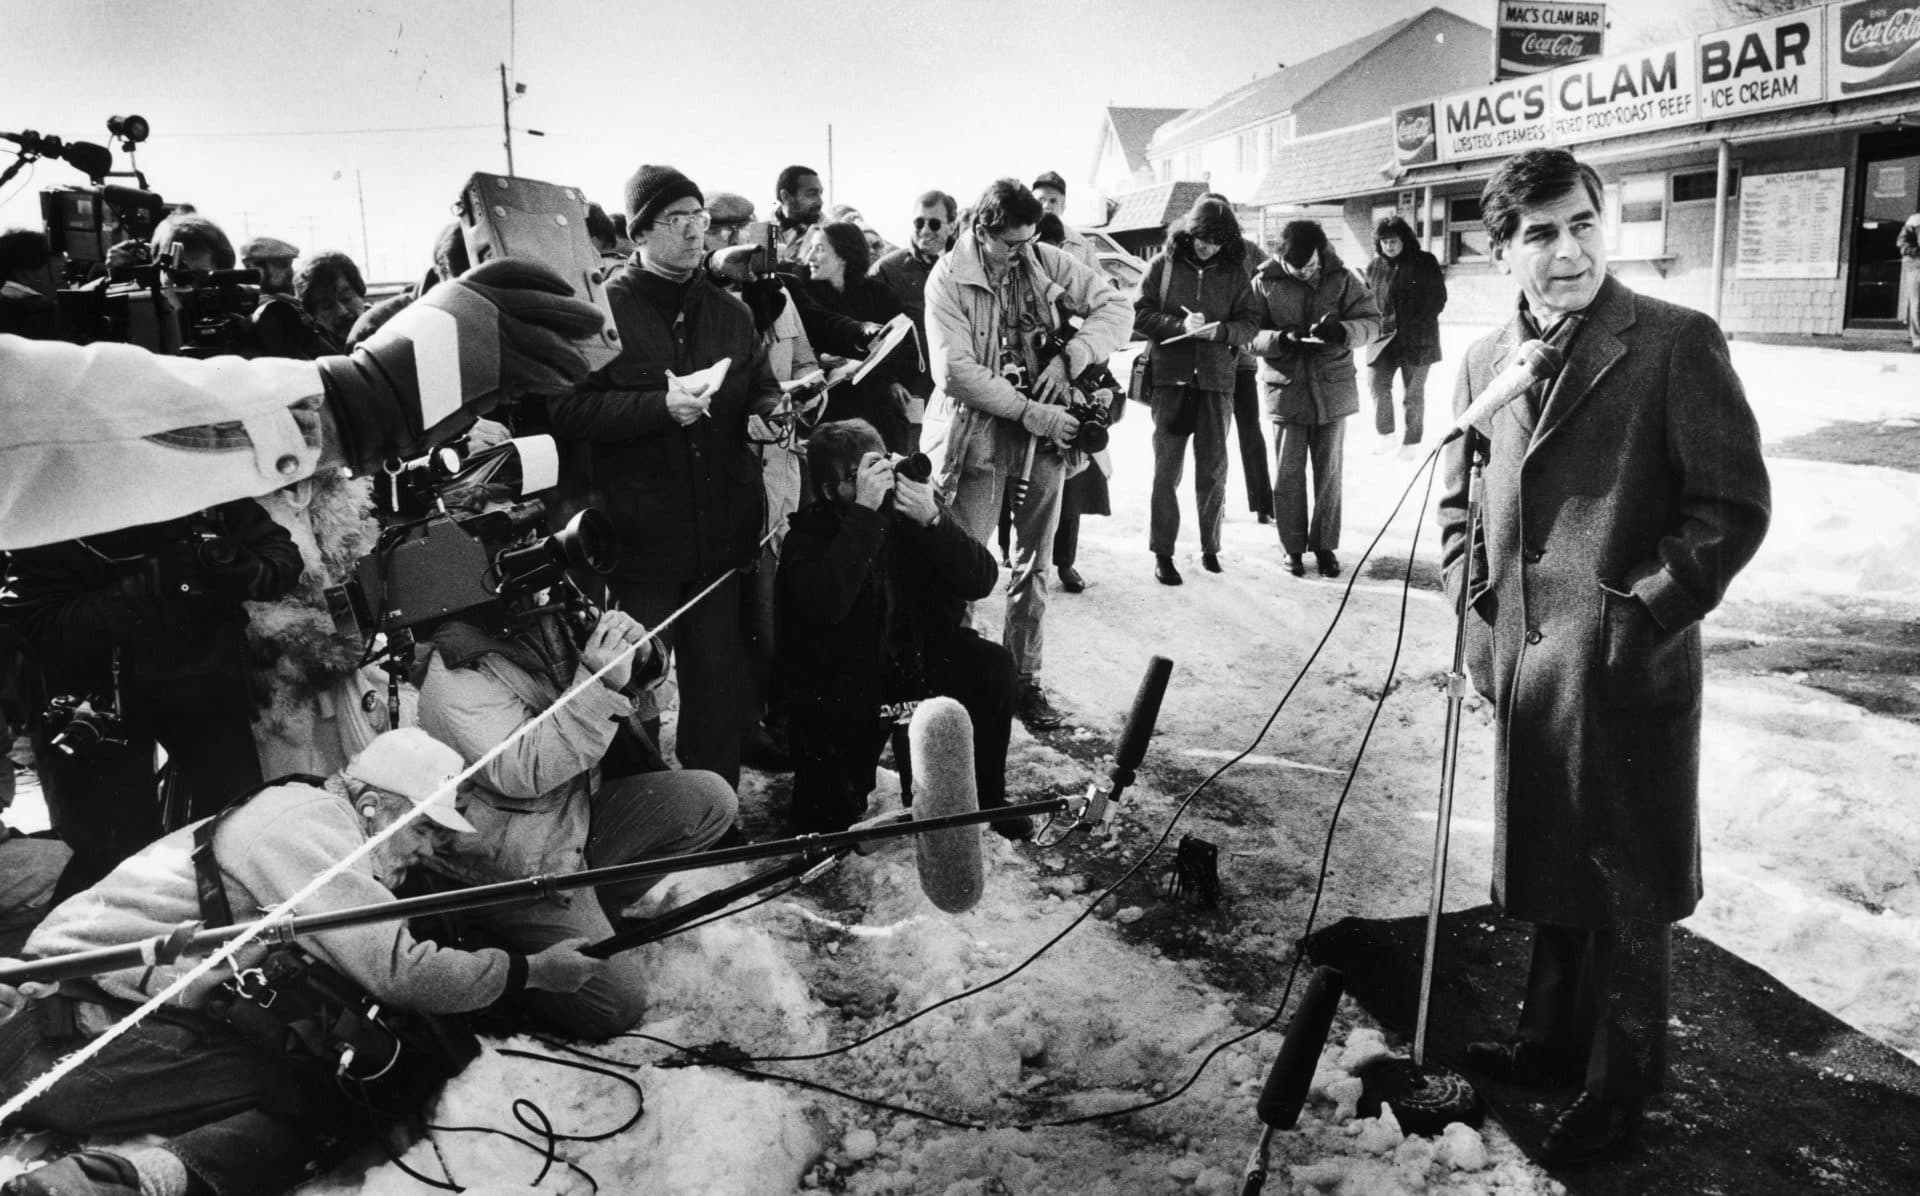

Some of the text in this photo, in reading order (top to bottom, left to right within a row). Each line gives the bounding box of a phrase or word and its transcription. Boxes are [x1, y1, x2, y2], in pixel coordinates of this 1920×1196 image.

[1506, 7, 1599, 26] MAC'S CLAM BAR
[1446, 22, 1810, 134] MAC'S CLAM BAR
[1658, 94, 1692, 119] BEEF
[1711, 87, 1735, 108] ICE
[1740, 75, 1798, 104] CREAM
